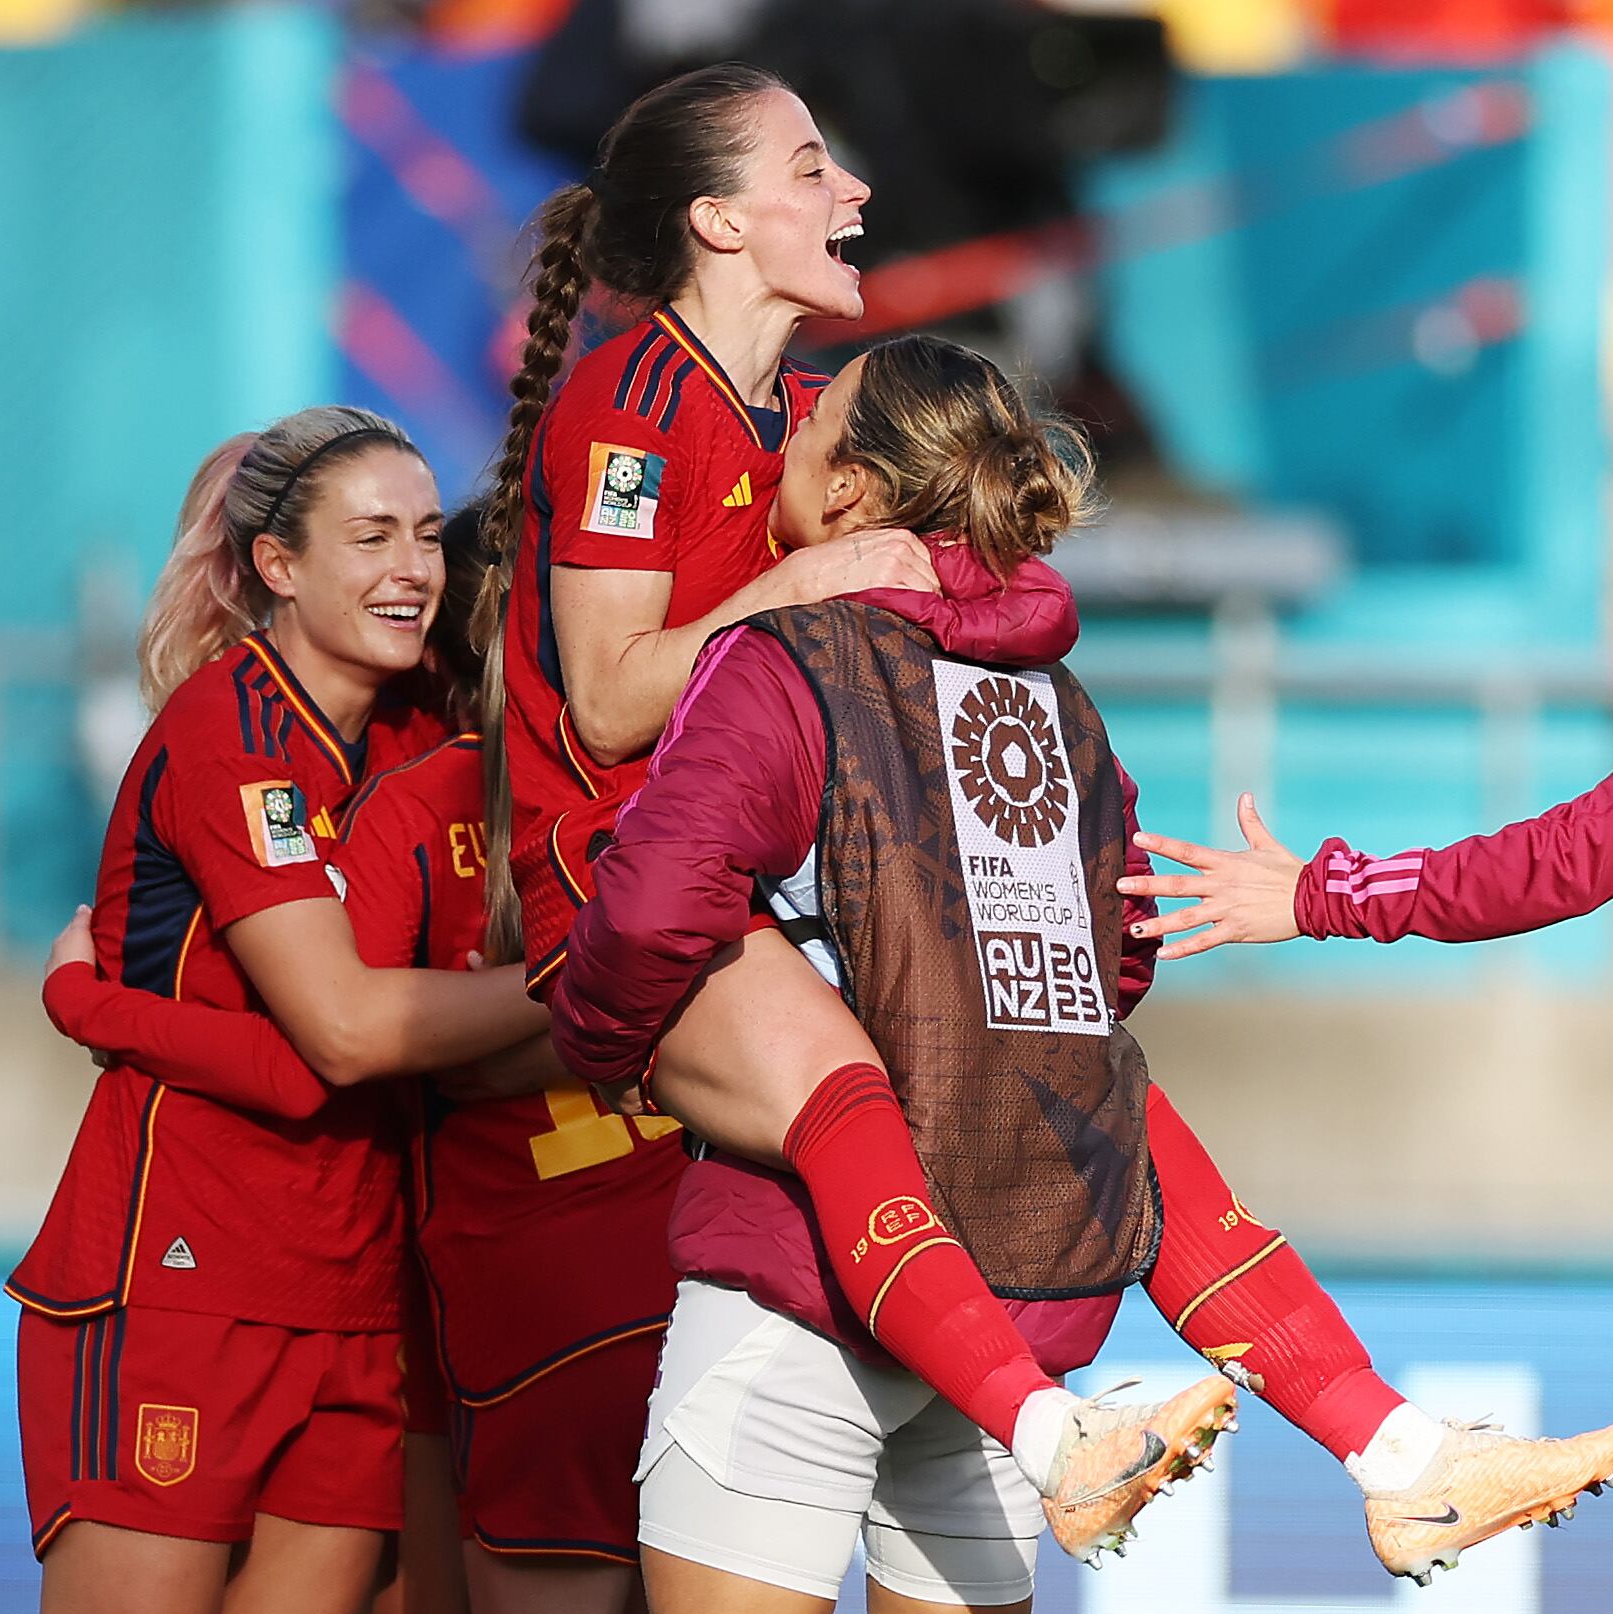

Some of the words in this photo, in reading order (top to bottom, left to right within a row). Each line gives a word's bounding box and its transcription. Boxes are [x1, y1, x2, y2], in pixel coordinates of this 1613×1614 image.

[968, 855, 1014, 878] FIFA
[973, 881, 1056, 902] WOMEN'S
[976, 903, 1041, 923] WORLD
[1043, 905, 1073, 925] CUP
[985, 938, 1041, 978] AU
[1049, 942, 1093, 983] 20
[991, 979, 1046, 1019] NZ
[1055, 983, 1102, 1023] 23
[1218, 1210, 1239, 1231] 19
[850, 1237, 869, 1264] 19
